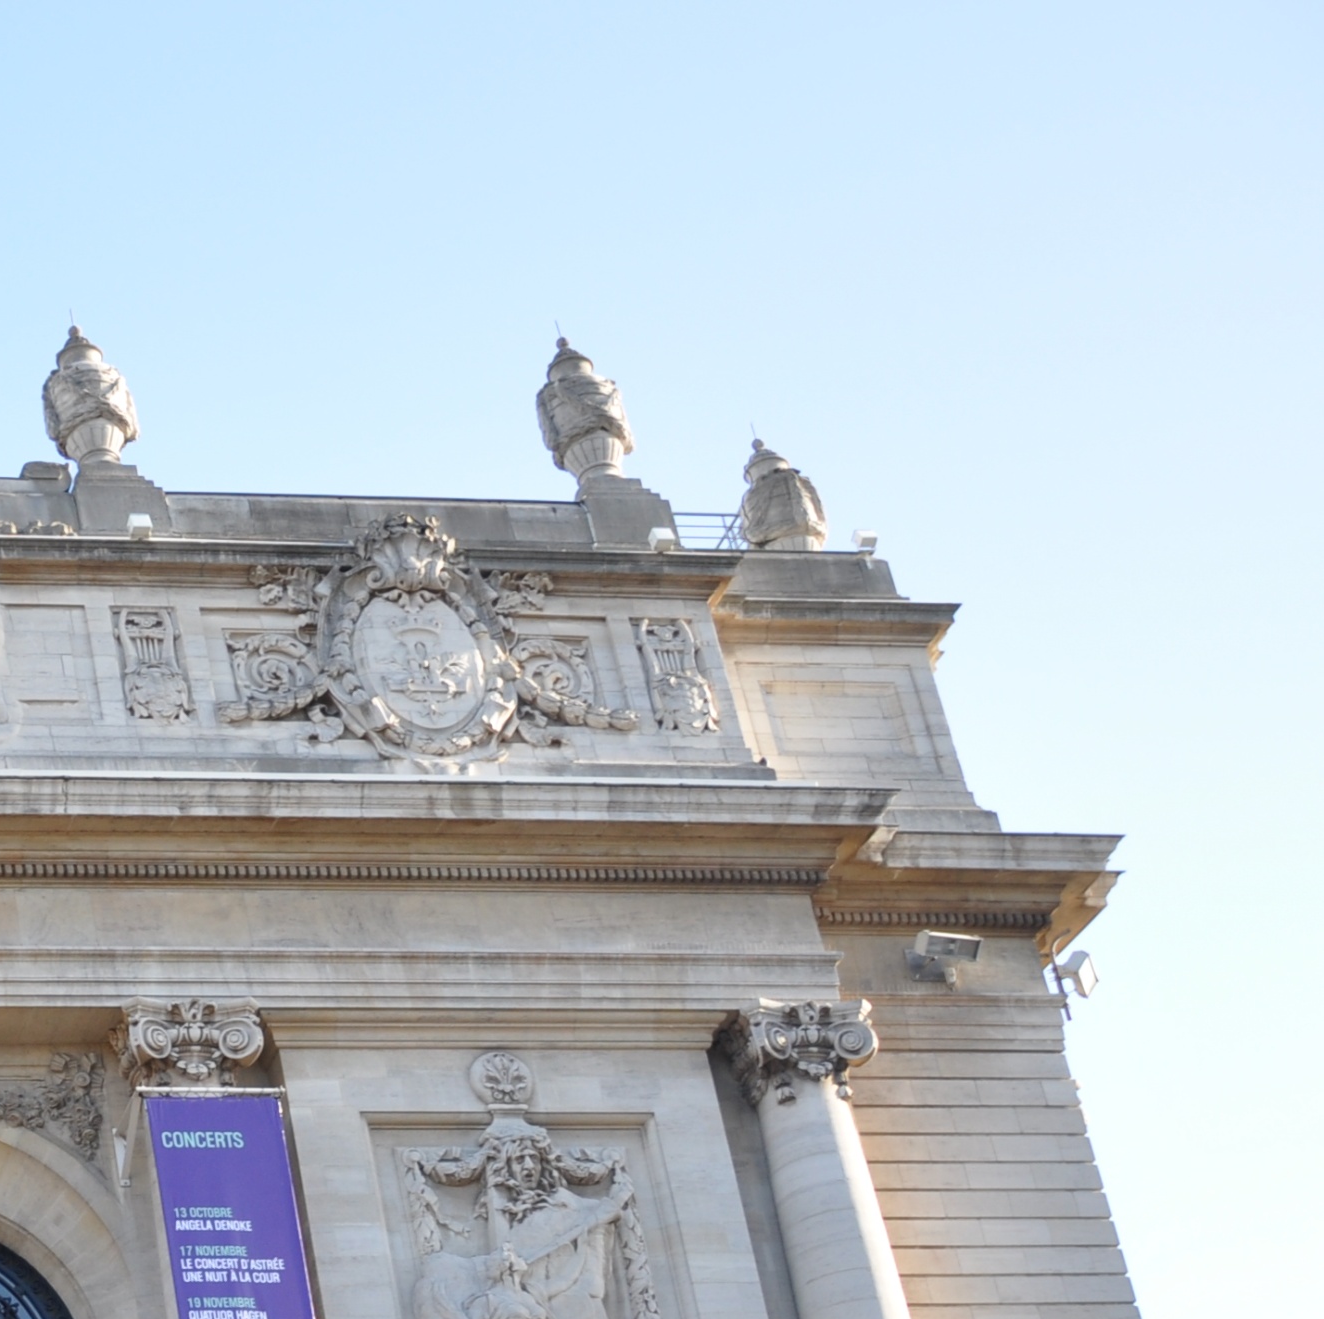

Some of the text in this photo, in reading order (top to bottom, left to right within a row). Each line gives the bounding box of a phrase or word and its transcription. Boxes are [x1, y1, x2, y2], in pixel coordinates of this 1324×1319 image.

[162, 1132, 244, 1148] CONCERTS
[175, 1207, 232, 1217] 13 OCTOBRE
[175, 1220, 251, 1231] ANGELA DENOKE
[181, 1246, 247, 1256] 17 NOVEMBRE
